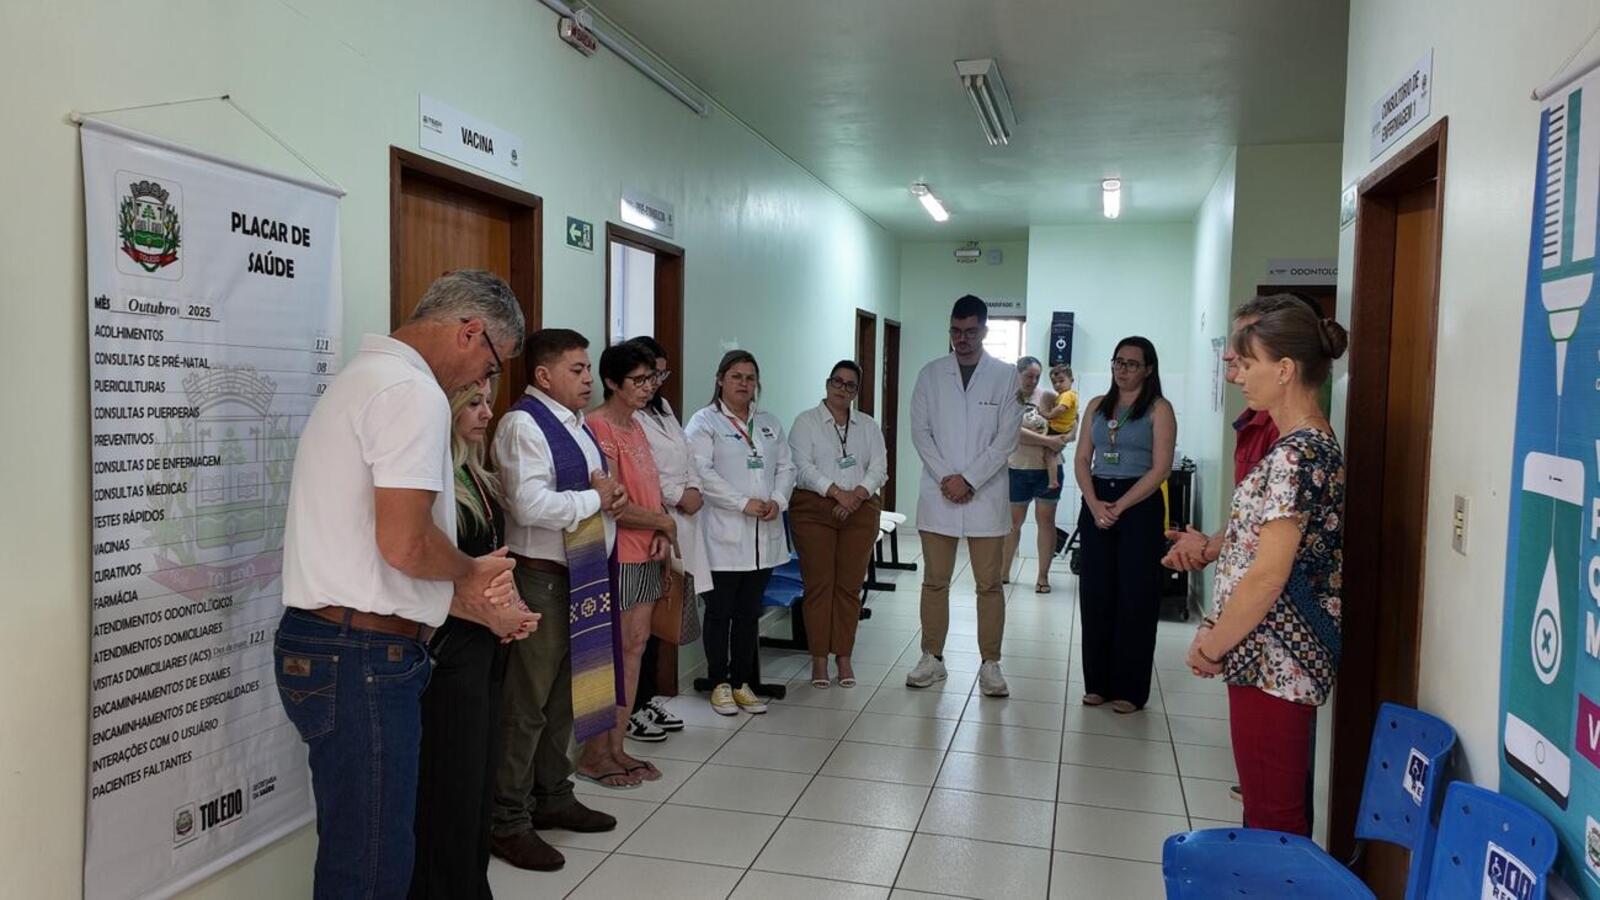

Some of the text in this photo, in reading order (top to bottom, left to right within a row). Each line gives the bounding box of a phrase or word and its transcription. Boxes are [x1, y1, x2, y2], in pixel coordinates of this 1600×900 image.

[1382, 70, 1420, 120] CONSULTÓRIO DE
[461, 126, 494, 155] VACINA
[232, 212, 310, 247] PLACAR DE
[248, 250, 294, 278] SAÚDE
[94, 294, 211, 318] MÊS Outubro 2025
[94, 324, 329, 350] ACOLHIMENTOS 121
[95, 352, 327, 373] CONSULTAS DE PRÉ-NATAL 08
[94, 380, 166, 393] PUERICULTURAS
[94, 406, 200, 420] CONSULTAS PUERPERAIS
[94, 433, 154, 446] PREVENTIVOS
[94, 455, 221, 474] CONSULTAS DE ENFERMAGEM
[94, 482, 187, 501] CONSULTAS MÉDICAS
[94, 508, 165, 528] TESTES RÁPIDOS
[94, 539, 130, 556] VACINAS
[94, 563, 142, 583] CURATIVOS
[94, 590, 138, 610] FARMÁCIA
[94, 609, 162, 637] ATENDIMENTOS
[93, 622, 223, 664] ATENDIMENTOS DOMICILIARES
[93, 672, 124, 691] VISITAS
[125, 654, 188, 682] DOMICILIARES
[189, 648, 212, 666] (ACS)
[250, 630, 264, 644] 121
[93, 666, 231, 718] ENCAMINHAMENTOS DE EXAMES
[92, 680, 260, 745] ENCAMINHAMENTOS DE ESPECIALIDADES
[92, 718, 218, 773] INTERAÇÕES COM O USUÁRIO
[92, 751, 192, 799] PACIENTES FALTANTES
[200, 788, 242, 831] TOLEDO
